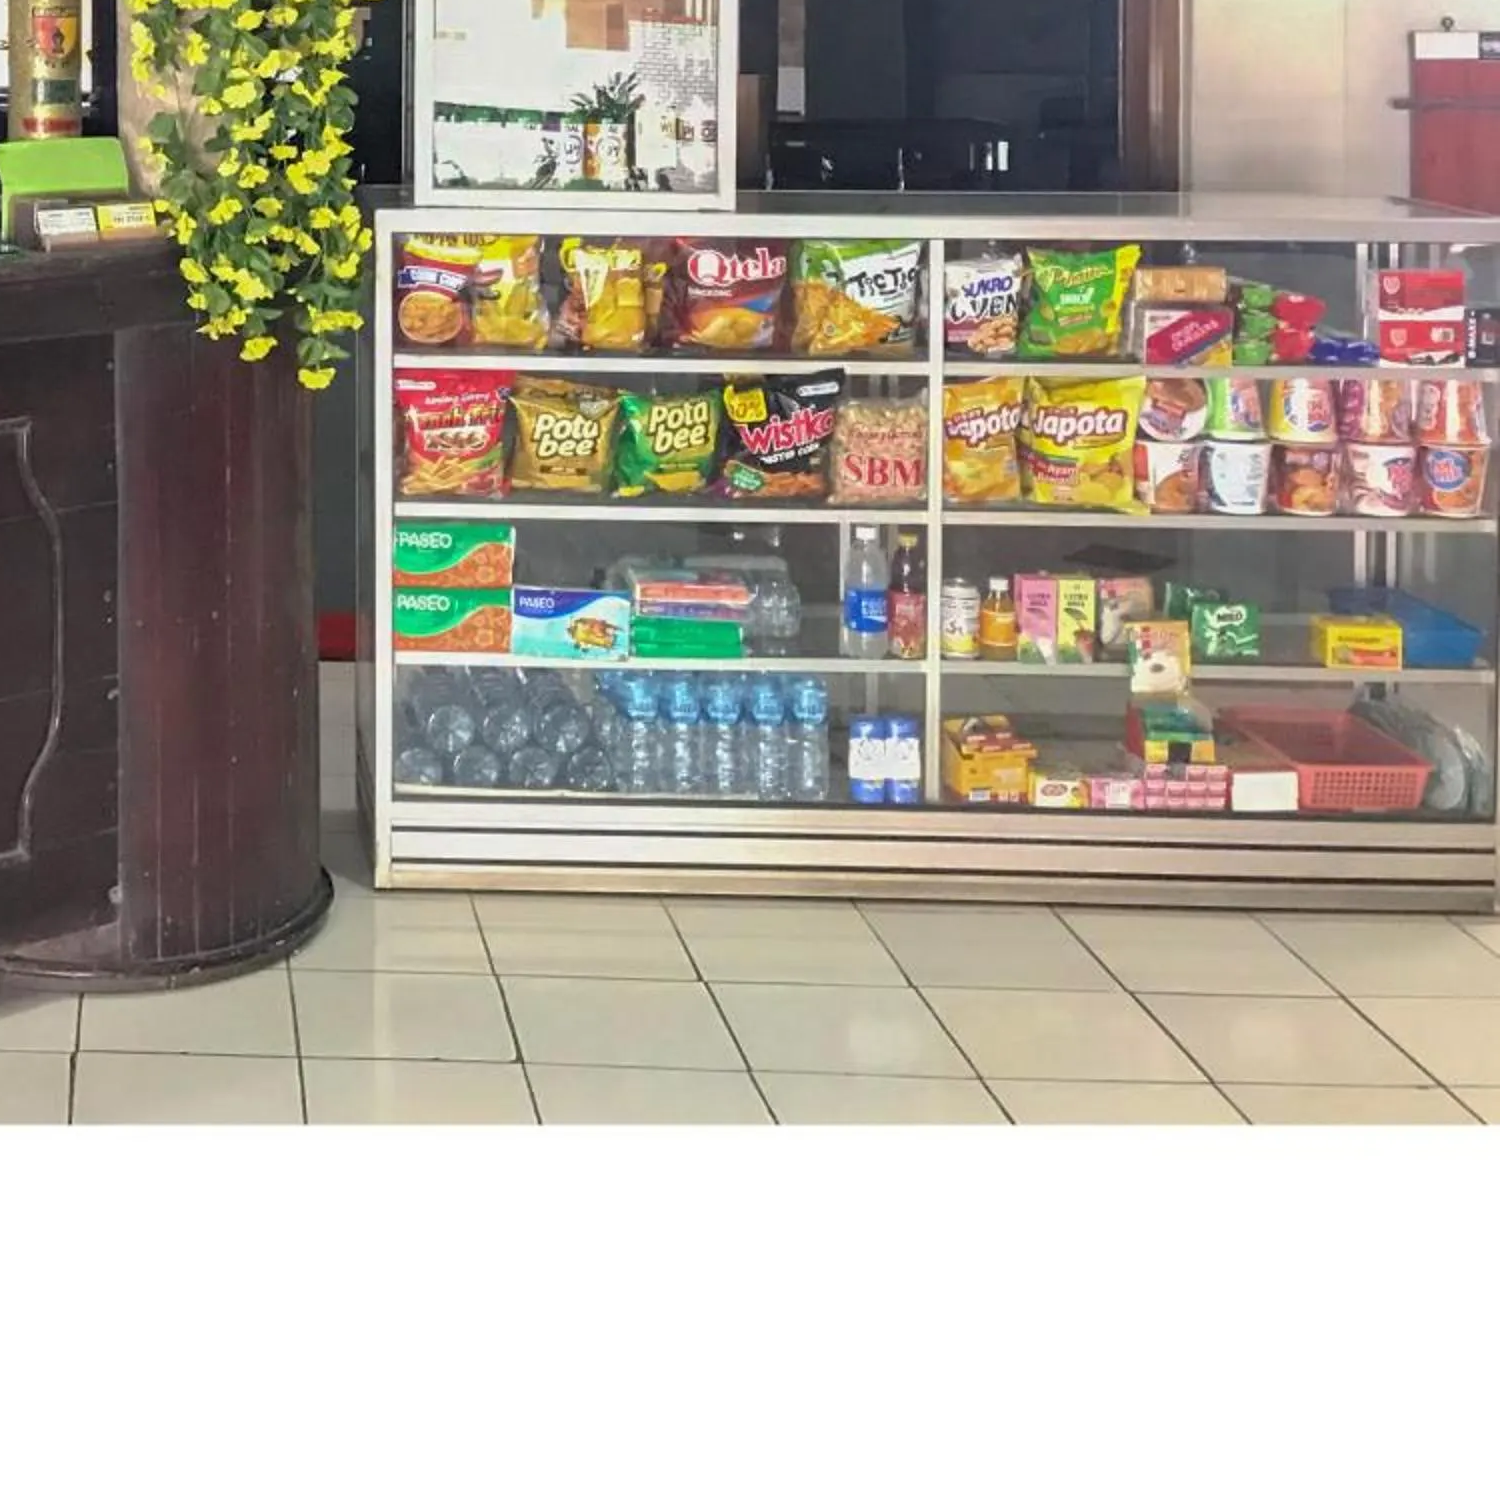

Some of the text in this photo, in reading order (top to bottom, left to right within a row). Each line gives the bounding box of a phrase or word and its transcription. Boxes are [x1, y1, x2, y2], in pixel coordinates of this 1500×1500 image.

[687, 247, 787, 287] Qtela
[532, 413, 599, 441] Pota
[649, 401, 709, 433] Pota
[1032, 409, 1126, 443] Japota
[538, 434, 595, 458] bee
[654, 423, 707, 454] bee
[843, 453, 923, 487] SBM
[399, 531, 453, 549] PASEO
[397, 594, 451, 611] PASEO
[519, 596, 555, 609] PASEO
